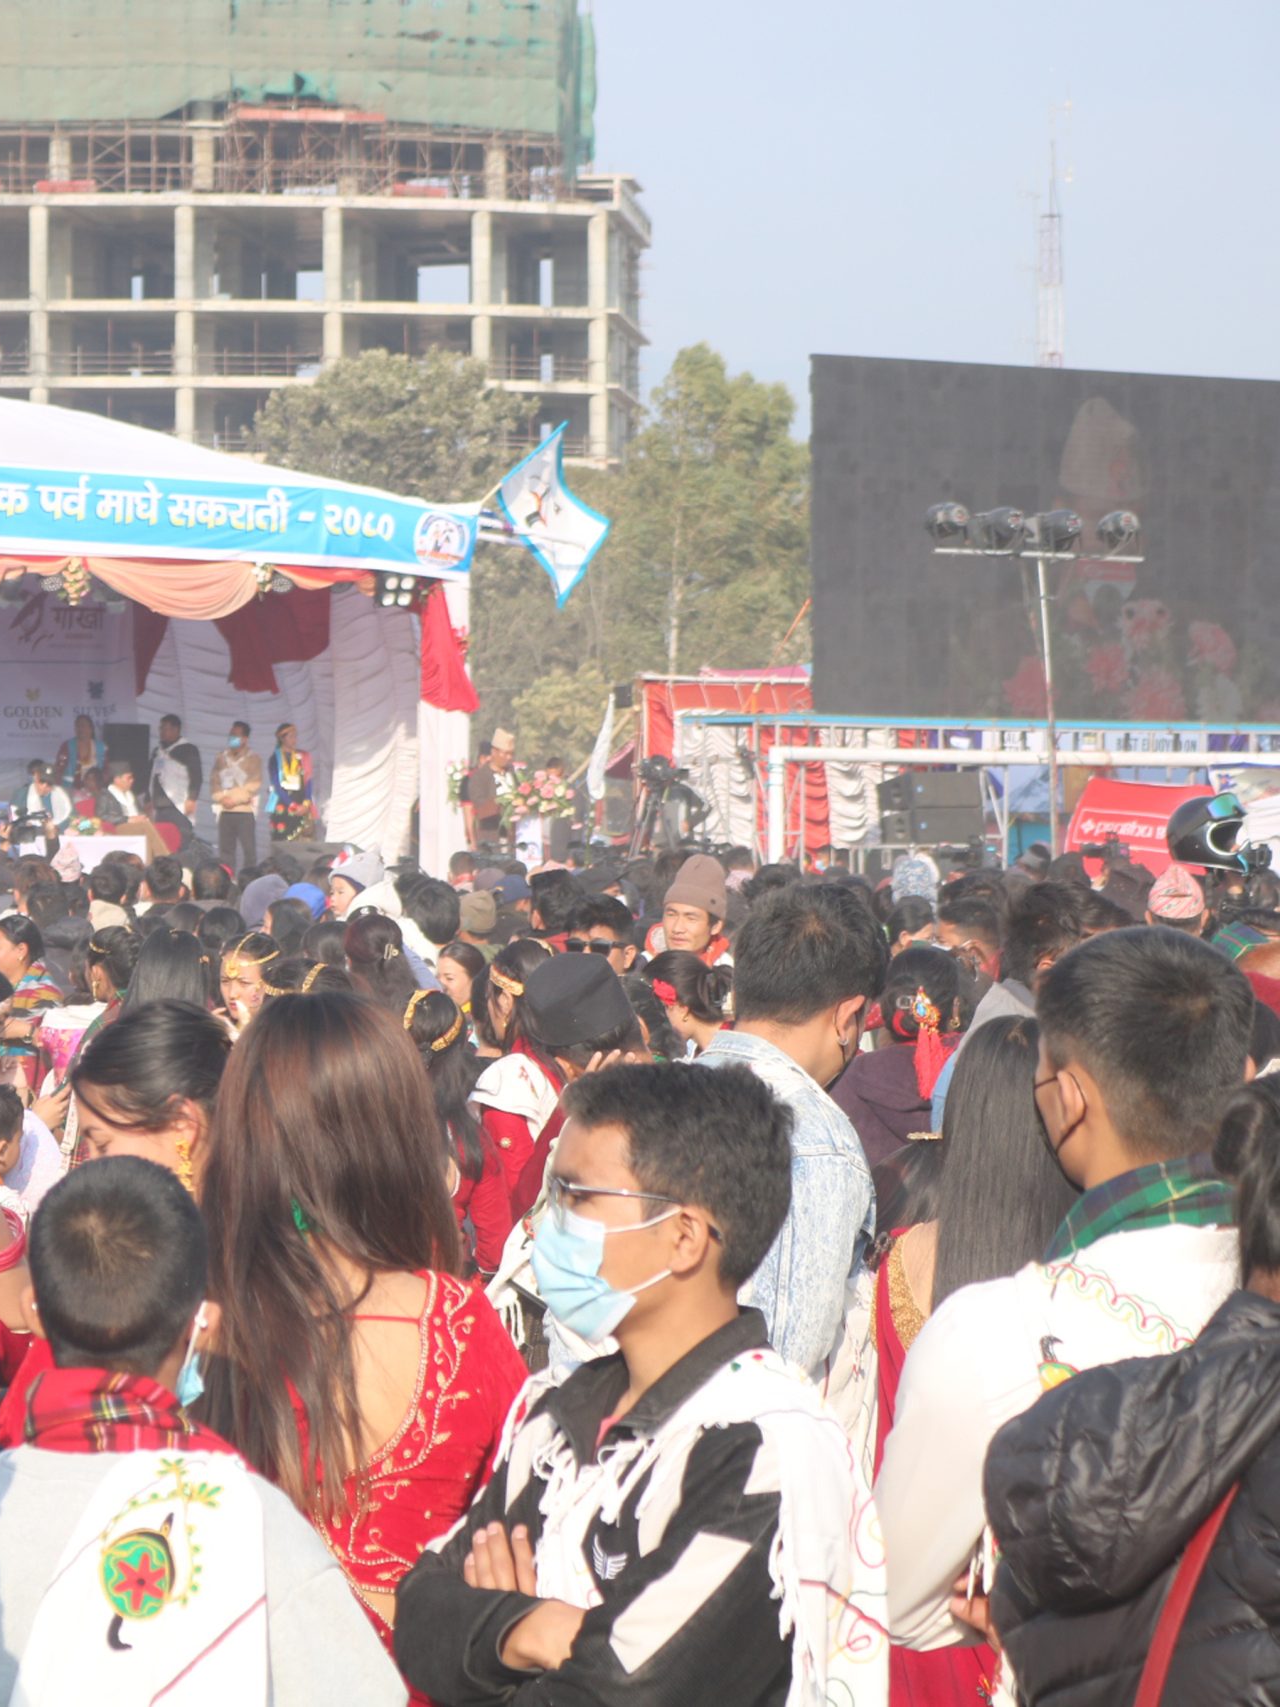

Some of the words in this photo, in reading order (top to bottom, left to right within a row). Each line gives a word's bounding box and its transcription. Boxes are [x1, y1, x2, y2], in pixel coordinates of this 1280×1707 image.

[35, 474, 90, 521] पर्व
[95, 480, 163, 527] माघे
[167, 486, 292, 533] सकराती
[322, 503, 396, 542] २०८०
[2, 705, 63, 718] GOLDEN
[18, 719, 49, 730] OAK
